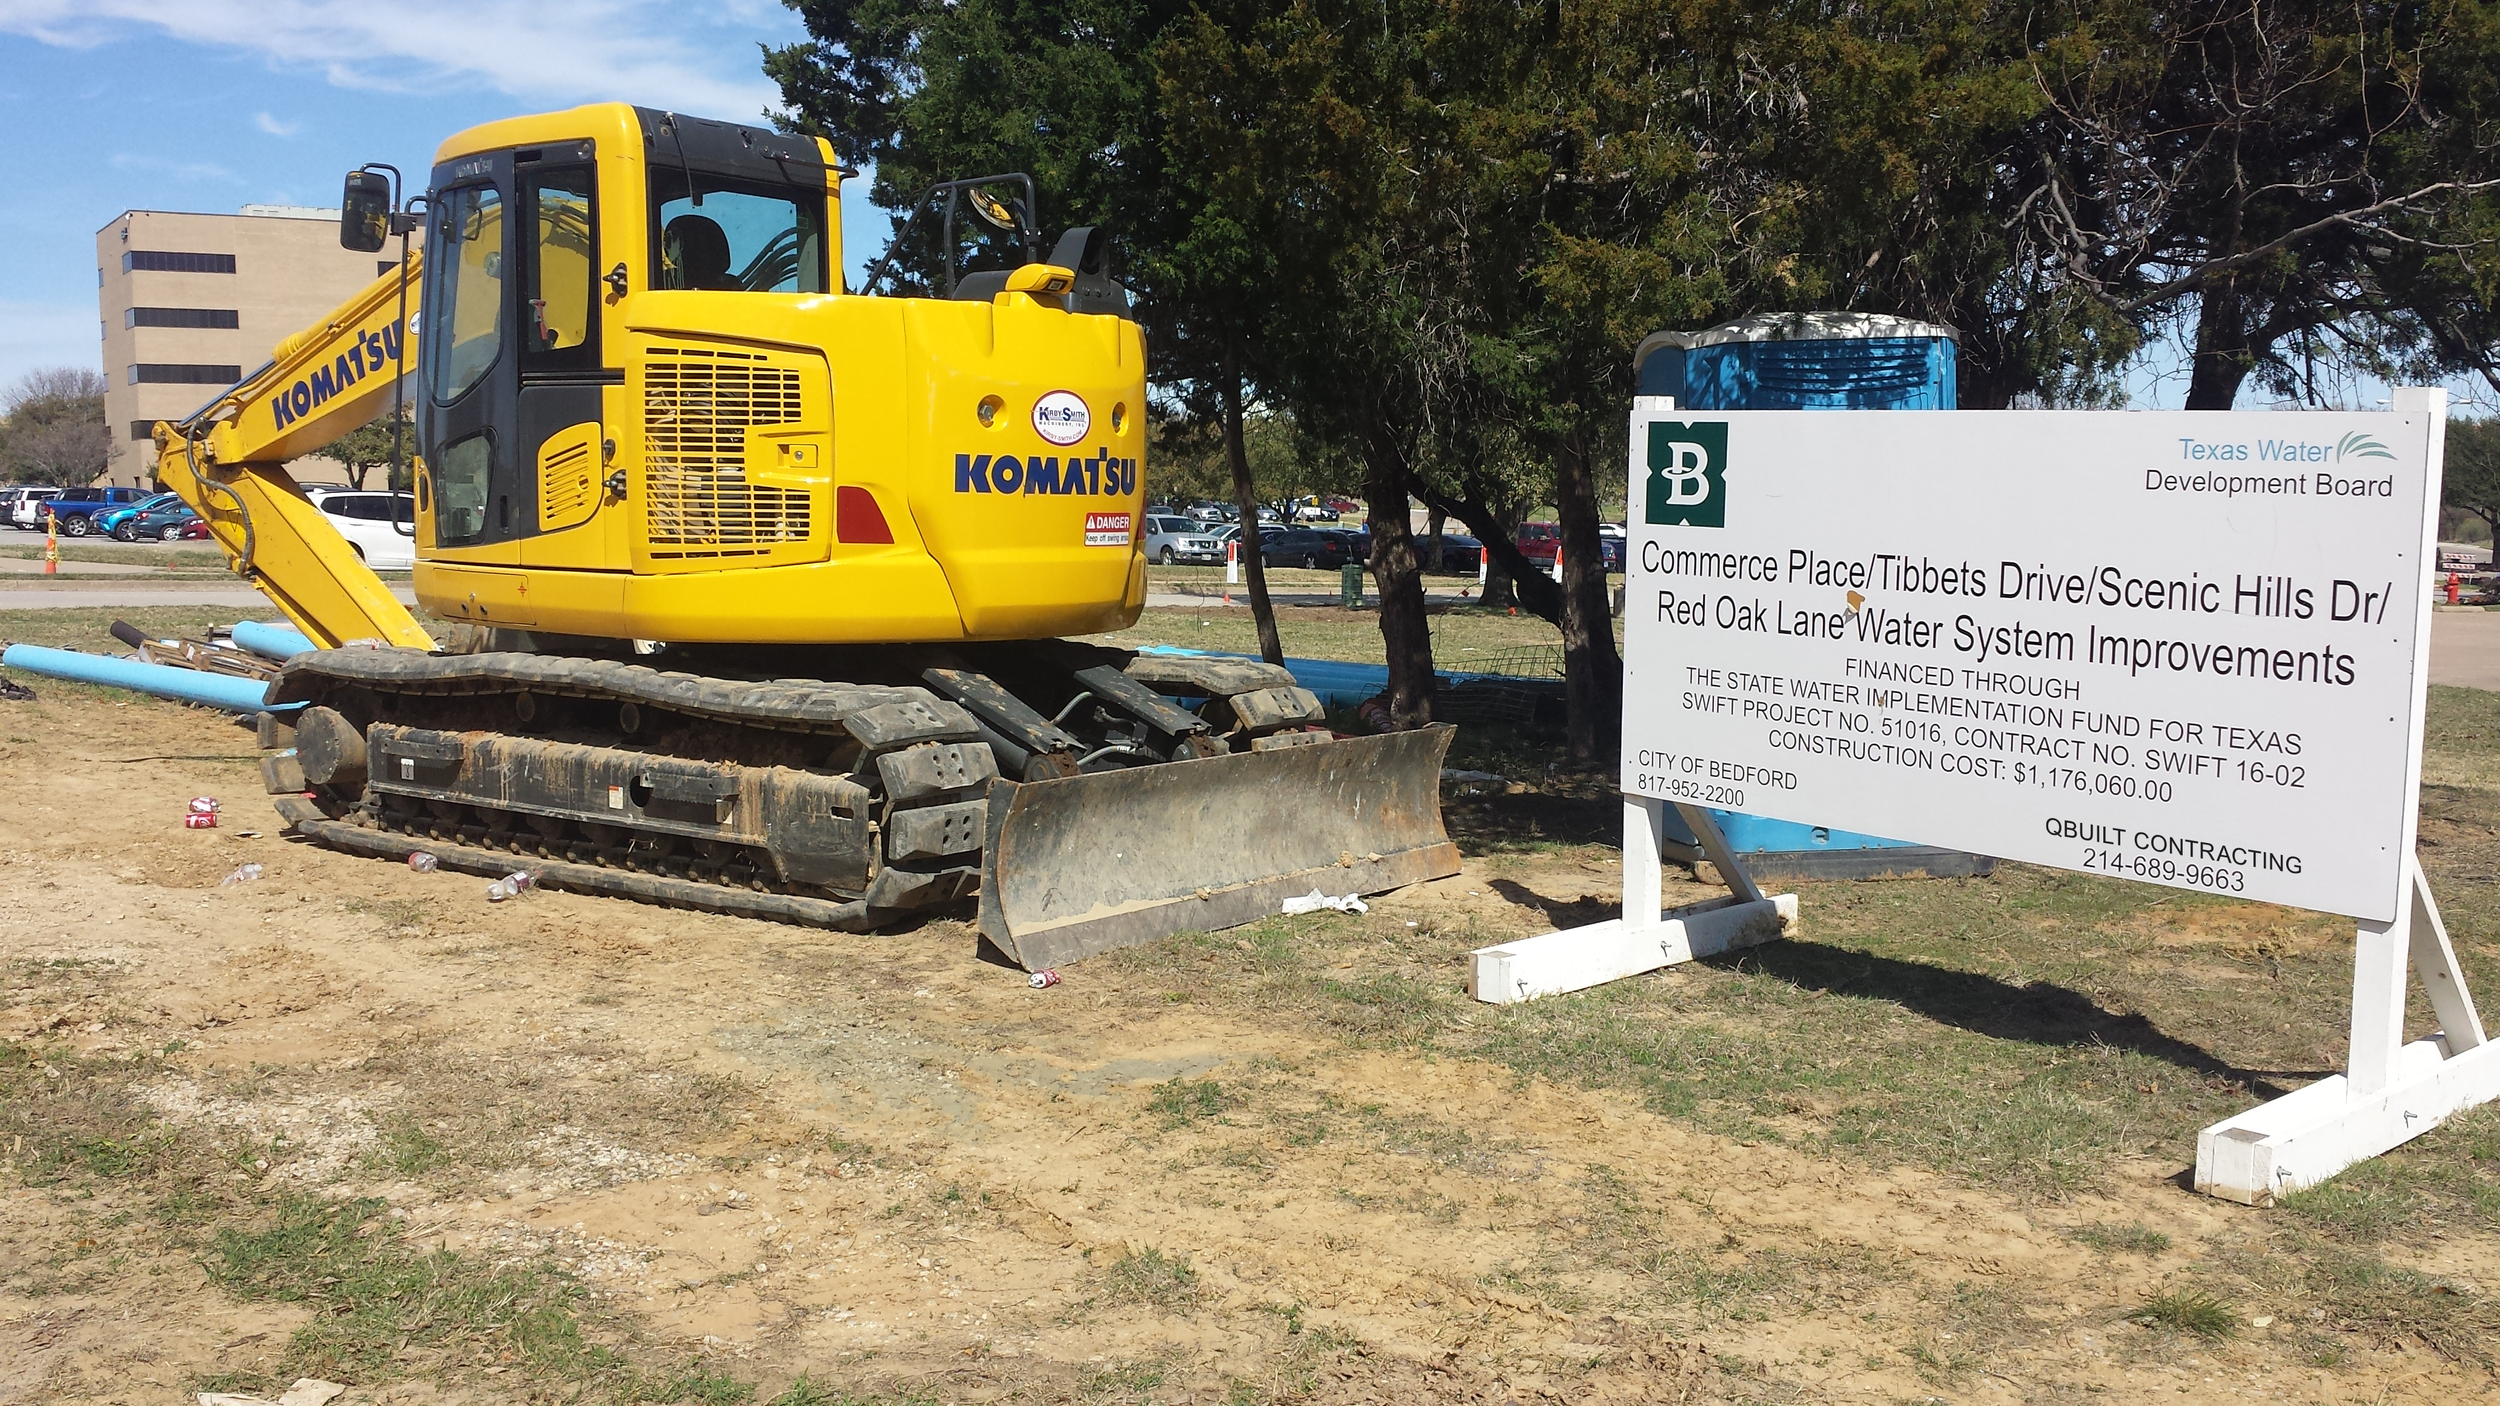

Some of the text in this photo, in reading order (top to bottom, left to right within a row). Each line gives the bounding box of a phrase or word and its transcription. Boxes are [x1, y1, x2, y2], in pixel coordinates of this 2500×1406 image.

[271, 318, 400, 432] KOMATSU
[1039, 406, 1086, 422] KIRBY-SMITH
[954, 447, 1136, 496] KOMATSU
[2180, 439, 2332, 461] Texas Water
[2146, 470, 2392, 498] Development Board
[1096, 516, 1129, 529] DANGER
[1643, 540, 2392, 624] Commerce Place/Tibbets Drive/Scenic Hills Dr/
[1658, 590, 2354, 685] Red Oak Lane Water System Improvements
[1846, 658, 2079, 700] FINANCED THROUGH
[1686, 667, 2301, 755] THE STATE WATER IMPLEMENTATION FUND FOR TEXAS
[1683, 692, 2304, 788] SWIFT PROJECT NO. 51016, CONTRACT NO. SWIFT 16-02
[1639, 750, 1796, 789] CITY OF BEDFORD
[1769, 730, 2172, 802] CONSTRUCTION COST: $1,176,060.00
[1639, 774, 1744, 806] 817-952-2200
[2046, 818, 2301, 874] QBUILT CONTRACTING
[2083, 848, 2244, 891] 214-689-9663
